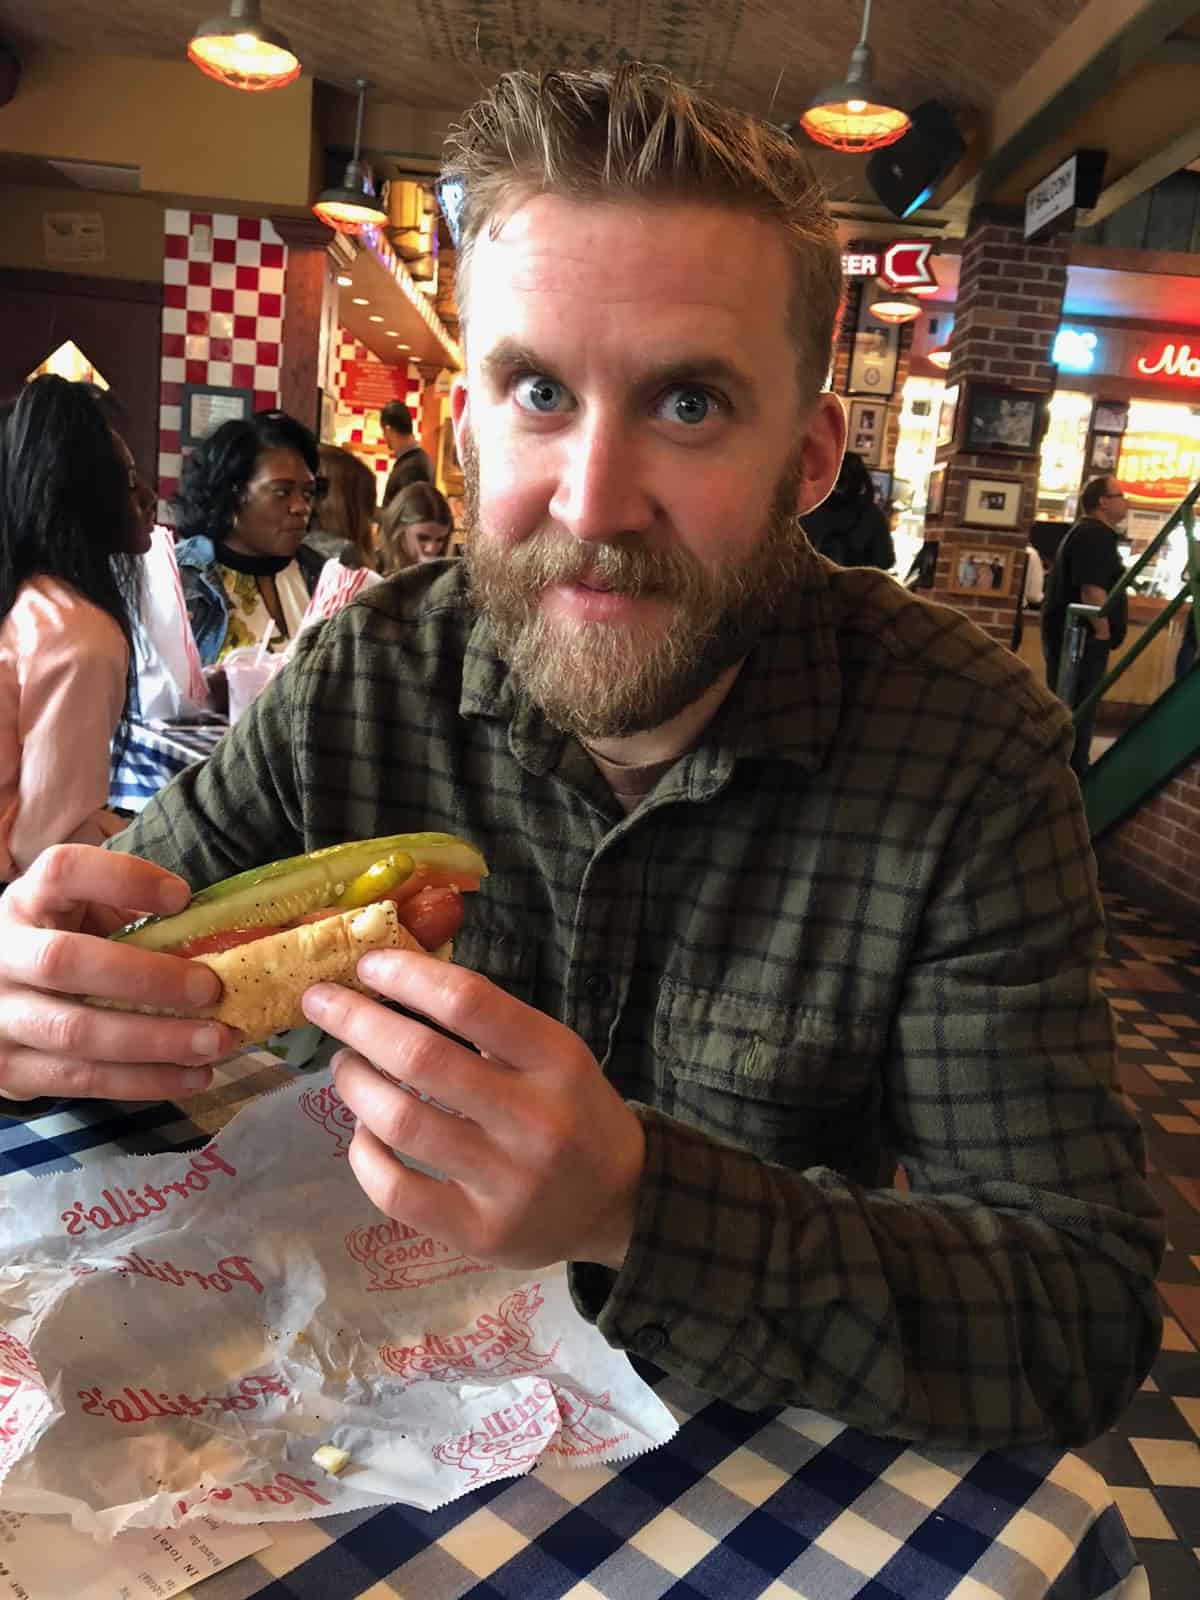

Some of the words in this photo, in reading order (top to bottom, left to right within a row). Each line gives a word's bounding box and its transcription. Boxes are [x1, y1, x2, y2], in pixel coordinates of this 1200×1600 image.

[841, 254, 877, 275] EER
[1137, 344, 1200, 377] Ma
[152, 1533, 184, 1564] Total
